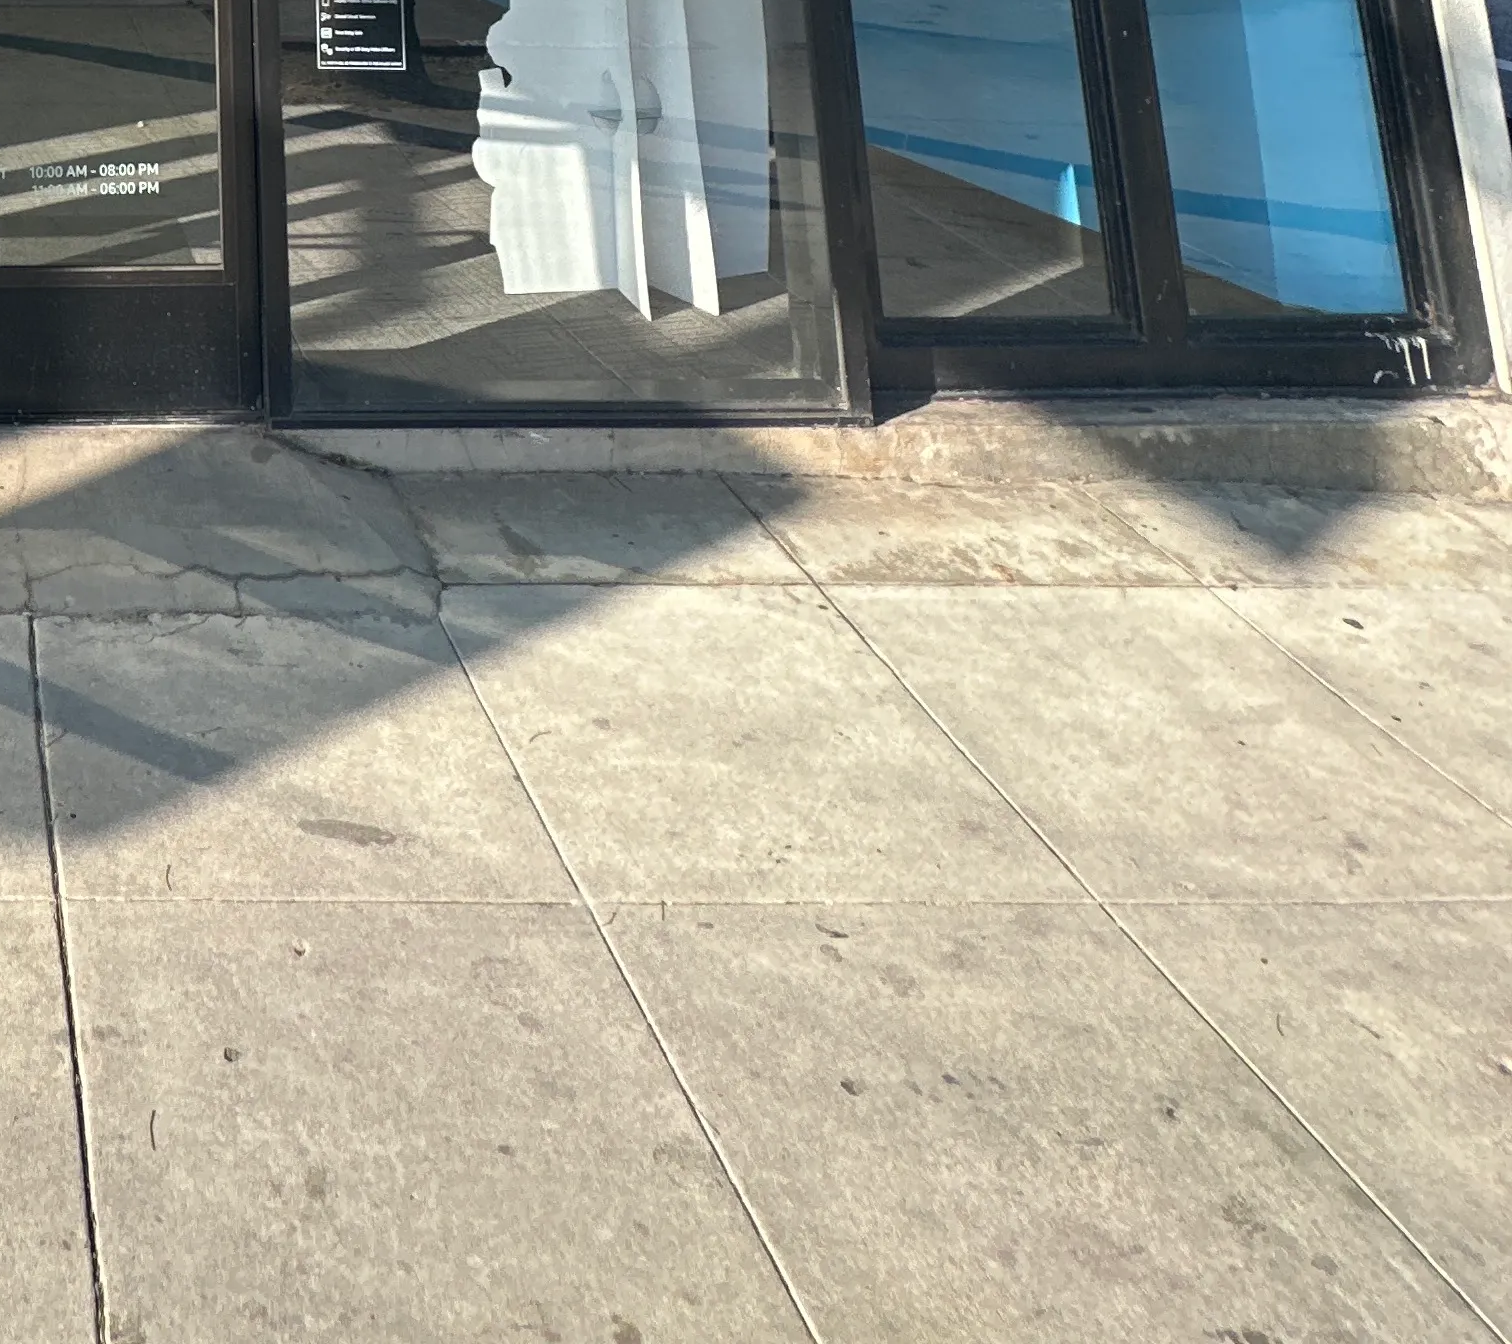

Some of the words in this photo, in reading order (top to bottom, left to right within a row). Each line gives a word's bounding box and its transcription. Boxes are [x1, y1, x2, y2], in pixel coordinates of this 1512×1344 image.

[29, 165, 63, 179] 10:00
[65, 164, 88, 179] AM
[99, 163, 136, 177] 08:00
[138, 163, 160, 176] PM
[66, 183, 88, 197] AM
[99, 182, 136, 195] 06:00
[138, 181, 160, 195] PM
